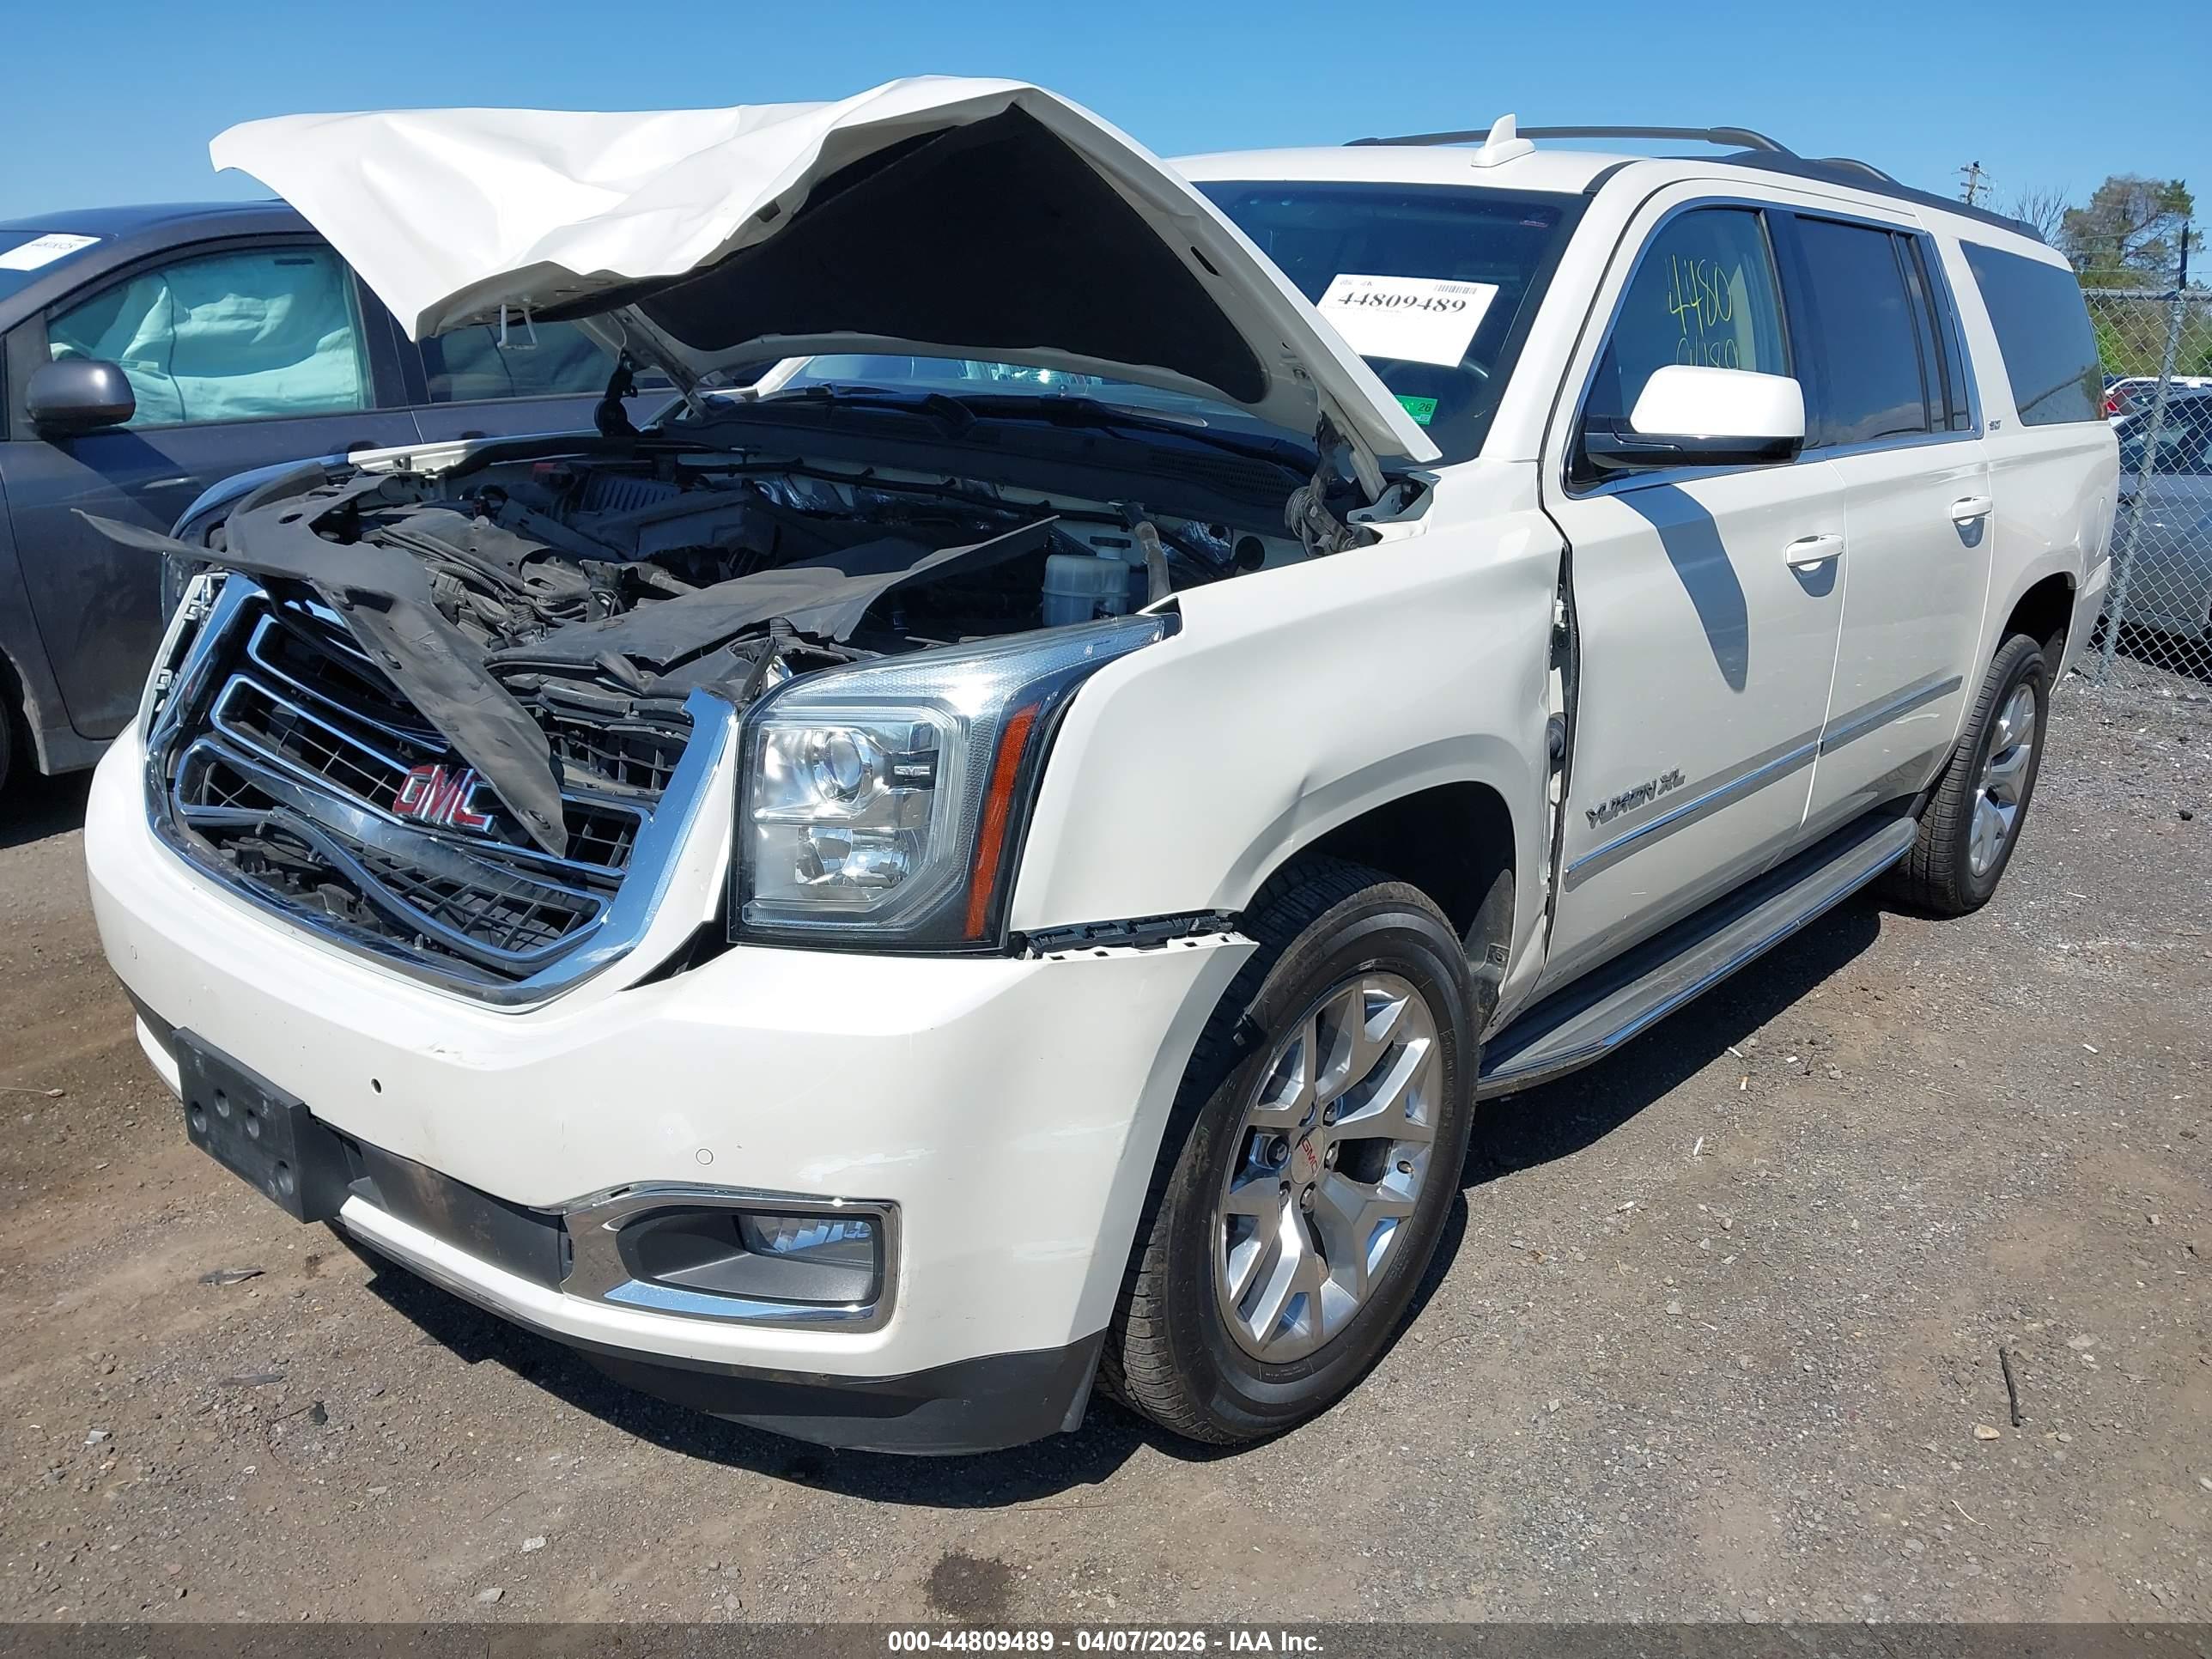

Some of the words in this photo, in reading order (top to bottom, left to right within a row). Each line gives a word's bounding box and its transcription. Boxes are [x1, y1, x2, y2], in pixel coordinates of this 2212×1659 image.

[1337, 291, 1467, 313] 44809489
[1664, 253, 1732, 337] 4480
[392, 763, 496, 835] GMC
[1300, 1136, 1319, 1175] GMC
